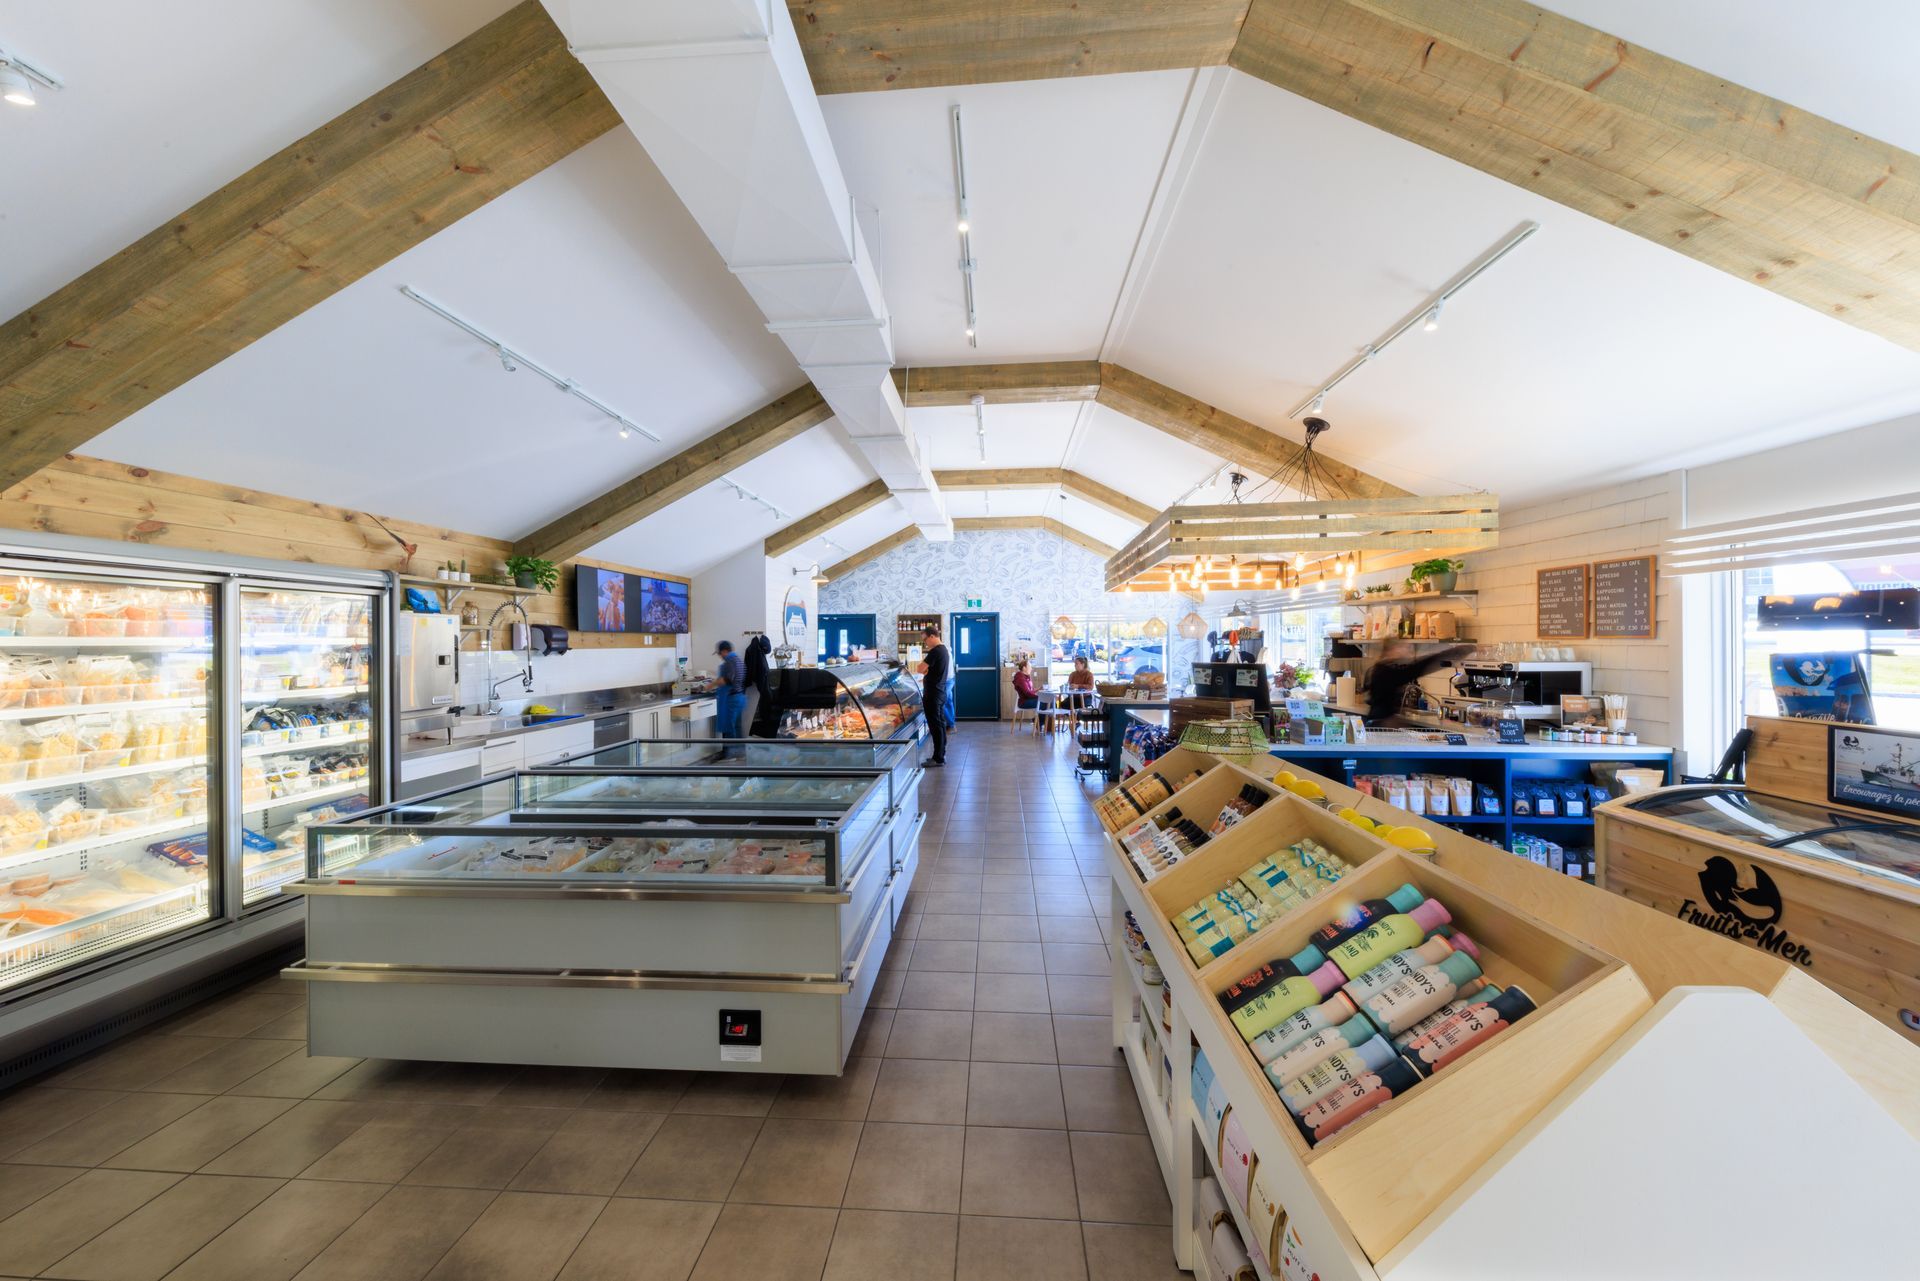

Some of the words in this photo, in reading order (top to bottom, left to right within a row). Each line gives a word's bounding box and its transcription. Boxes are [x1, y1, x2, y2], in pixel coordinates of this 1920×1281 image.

[1843, 784, 1892, 804] Encouragez
[1894, 794, 1904, 804] la
[1379, 921, 1396, 937] NDY'S
[1678, 898, 1742, 940] Fruits
[1743, 926, 1760, 940] de
[1757, 926, 1812, 966] Mer
[1296, 1012, 1312, 1030] DY'S
[1348, 1078, 1366, 1097] DY'S
